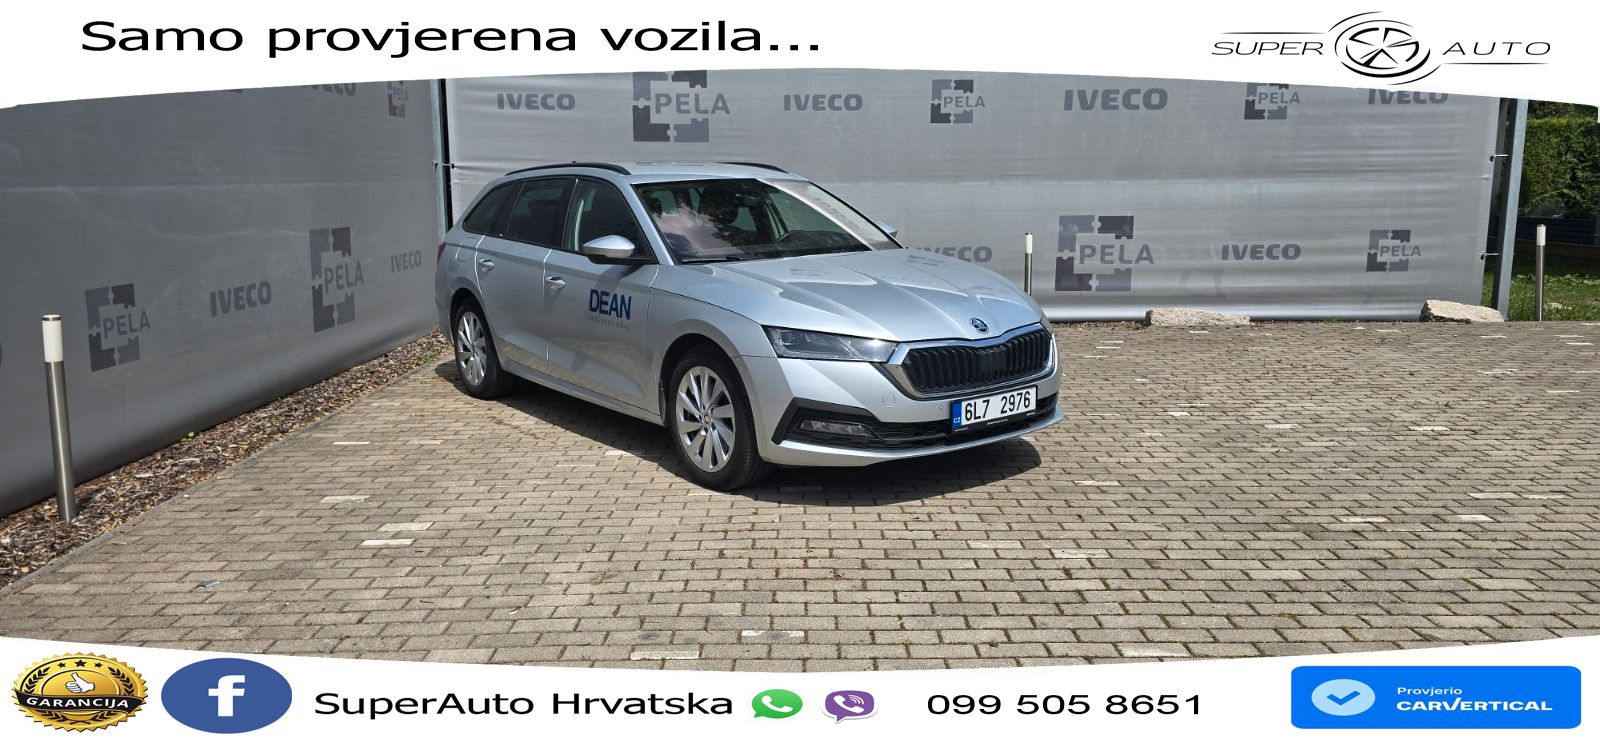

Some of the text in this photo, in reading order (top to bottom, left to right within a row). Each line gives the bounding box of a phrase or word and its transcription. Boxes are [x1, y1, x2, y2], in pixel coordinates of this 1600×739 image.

[497, 93, 576, 111] IVECO
[655, 93, 731, 115] PELA
[783, 93, 863, 112] IVECO
[943, 95, 985, 108] PELA
[1063, 88, 1168, 111] IVECO
[1257, 92, 1300, 104] PELA
[390, 249, 422, 274] IVECO
[915, 246, 992, 262] ECO
[1079, 243, 1154, 265] PELA
[1221, 243, 1301, 261] IVECO
[1379, 246, 1421, 257] PELA
[322, 260, 365, 295] PELA
[210, 279, 272, 318] IVECO
[589, 288, 632, 320] DEAN
[102, 309, 151, 340] PELA
[965, 390, 1031, 421] 6L7 2976
